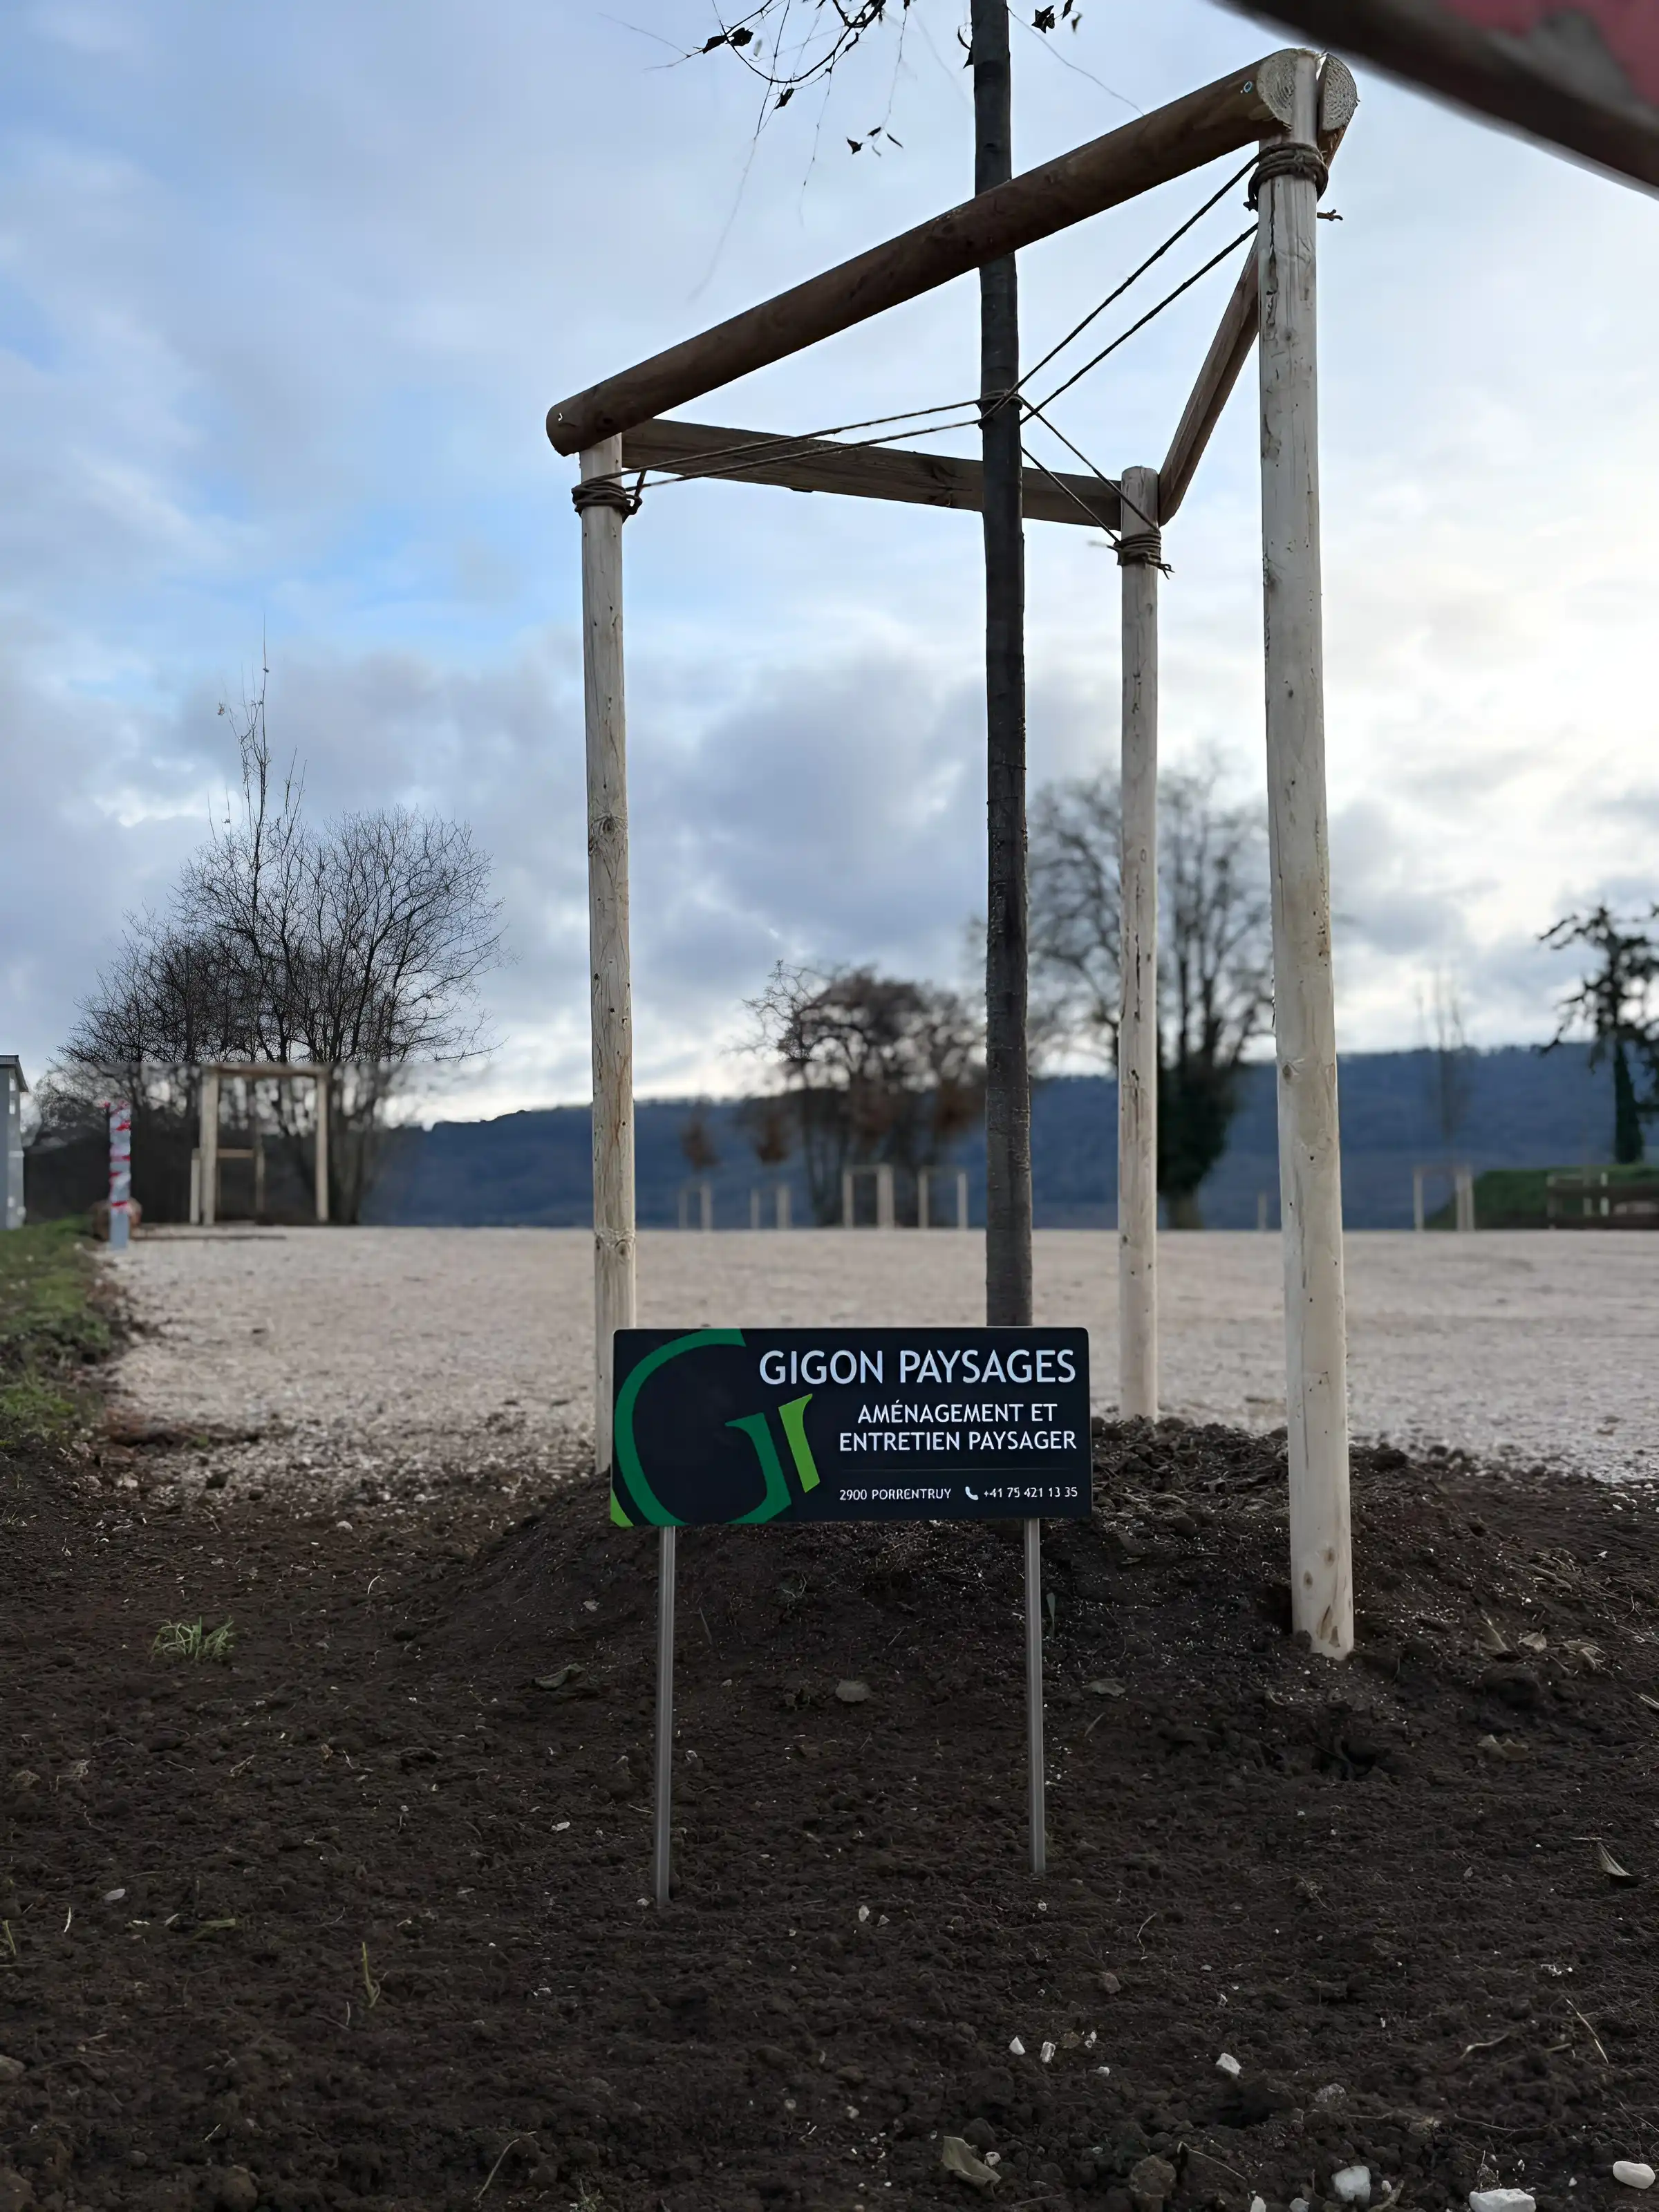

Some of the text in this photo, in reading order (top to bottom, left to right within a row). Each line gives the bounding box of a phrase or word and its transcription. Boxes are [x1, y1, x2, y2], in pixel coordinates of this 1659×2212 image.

[759, 1349, 1076, 1385] GIGON PAYSAGES
[857, 1400, 1058, 1424] AMÉNAGEMENT ET
[840, 1431, 1077, 1452] ENTRETIEN PAYSAGER
[839, 1488, 952, 1501] 2900 PORRENTRUY
[984, 1487, 1078, 1499] +41 75 421 13 35
